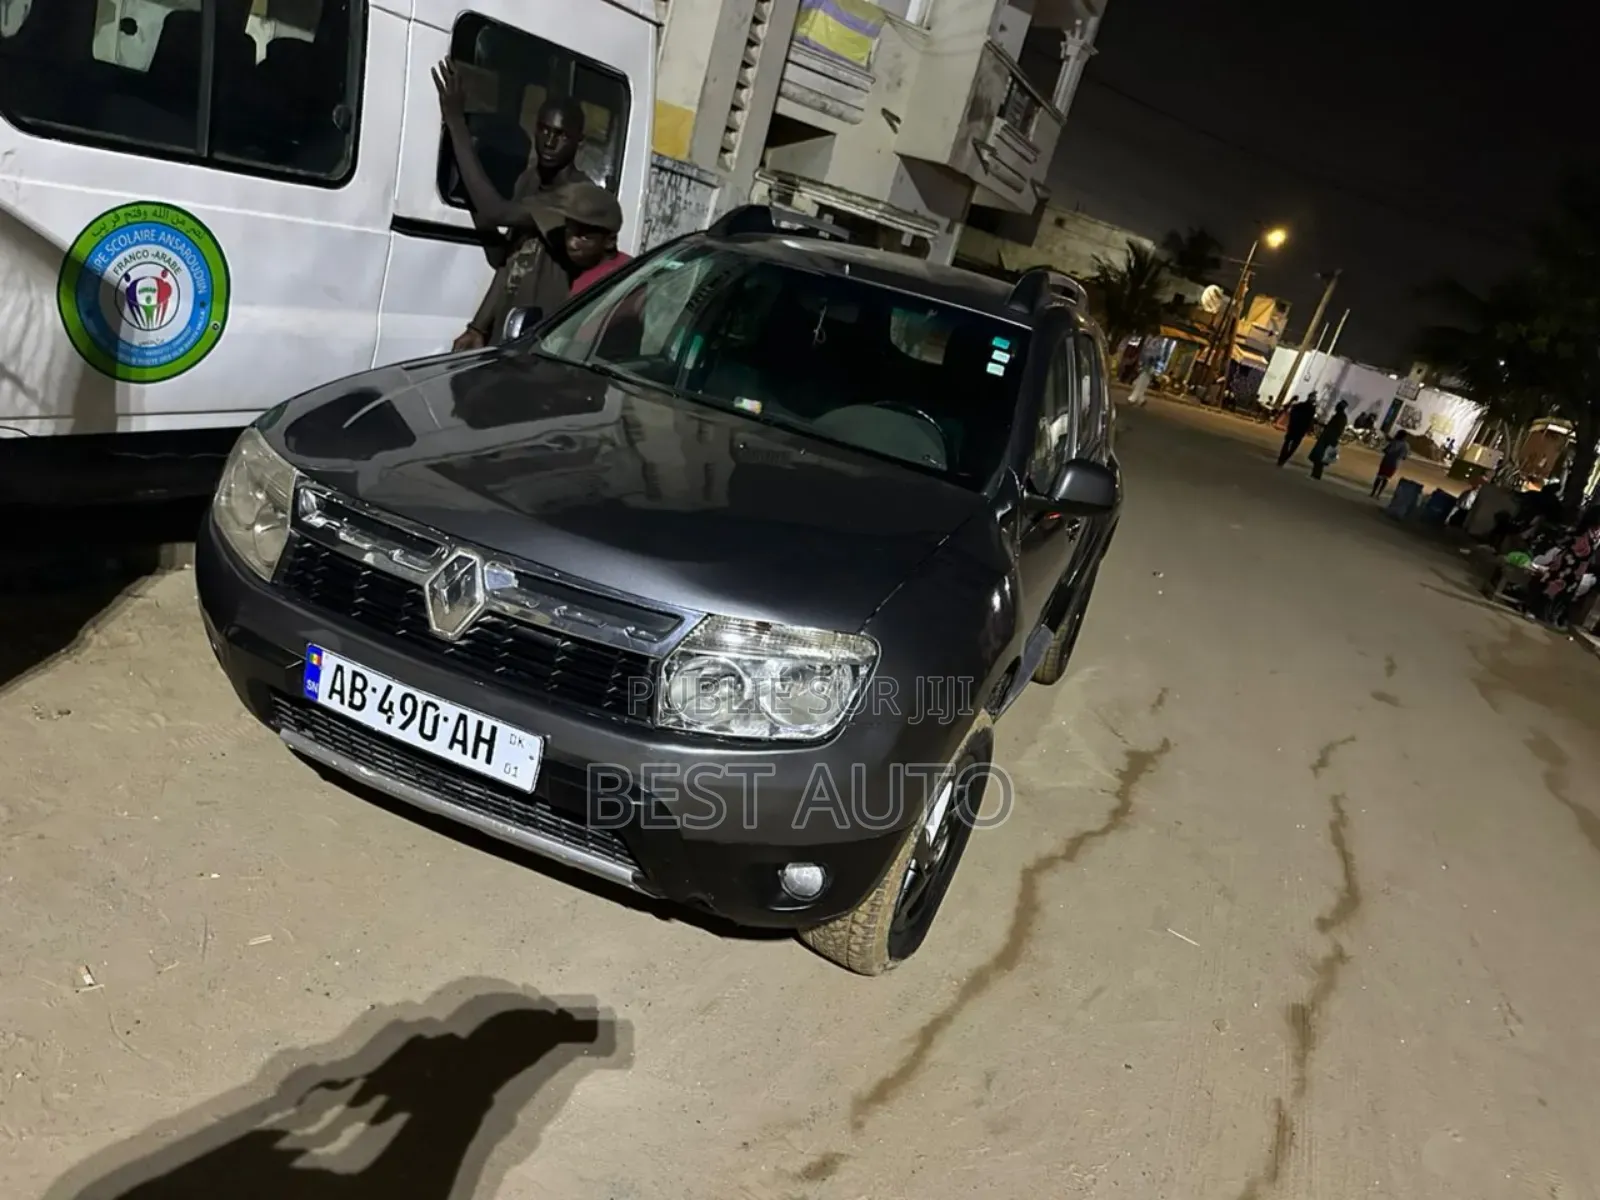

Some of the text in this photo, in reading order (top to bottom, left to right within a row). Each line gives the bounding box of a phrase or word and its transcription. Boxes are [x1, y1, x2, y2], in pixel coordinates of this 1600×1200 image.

[106, 229, 157, 259] SCOLAIRE
[113, 249, 149, 275] FRANCO
[306, 678, 320, 692] SN
[509, 732, 525, 749] DK
[503, 762, 519, 778] 01
